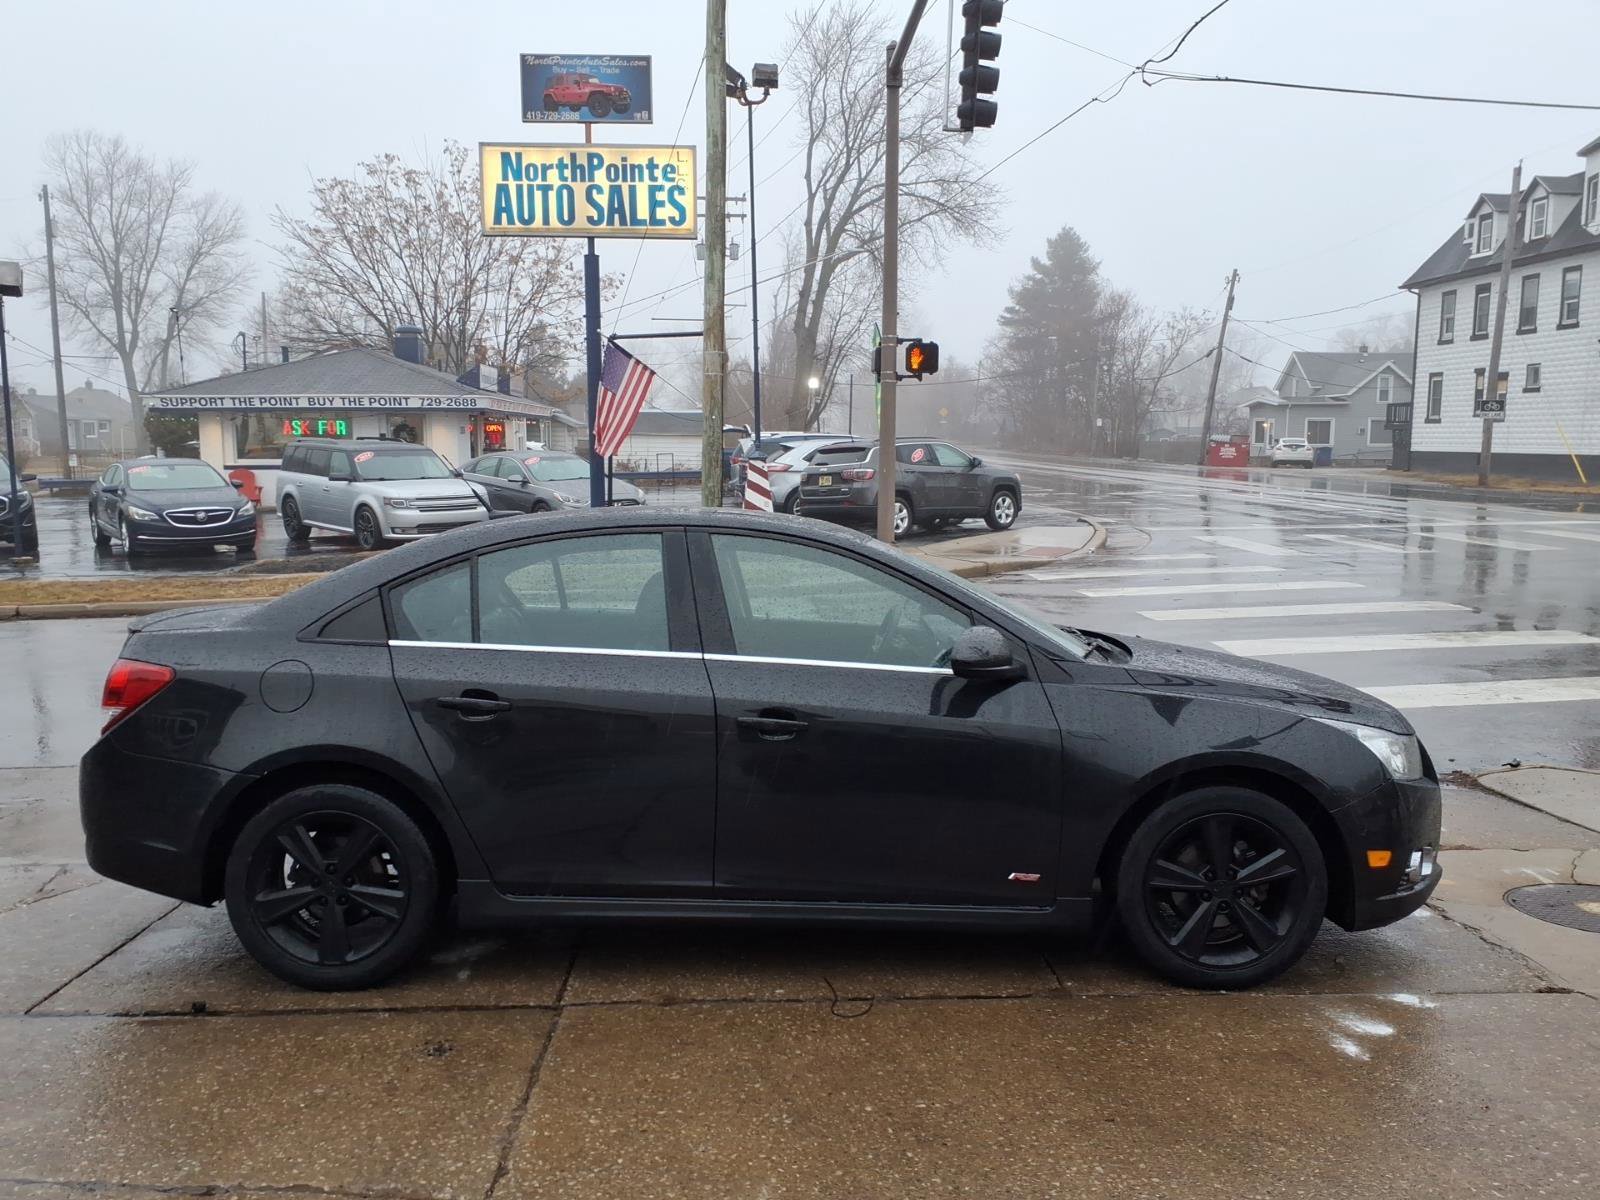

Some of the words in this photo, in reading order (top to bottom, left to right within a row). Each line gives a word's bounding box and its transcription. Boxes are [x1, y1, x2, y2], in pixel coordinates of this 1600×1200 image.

[524, 56, 648, 66] NorthPointeAutoSales.com
[552, 66, 567, 74] Buy
[526, 111, 580, 120] 419-729-2688
[500, 152, 676, 182] NorthPointe
[493, 184, 575, 227] AUTO
[585, 184, 687, 227] SALES
[160, 397, 225, 407] SUPPORT
[230, 397, 256, 407] THE
[259, 397, 300, 407] POINT
[308, 397, 335, 407] BUY
[340, 397, 364, 407] THE
[369, 397, 410, 407] POINT
[419, 397, 477, 407] 729-2688
[283, 420, 310, 436] ASK
[318, 420, 346, 436] FOR
